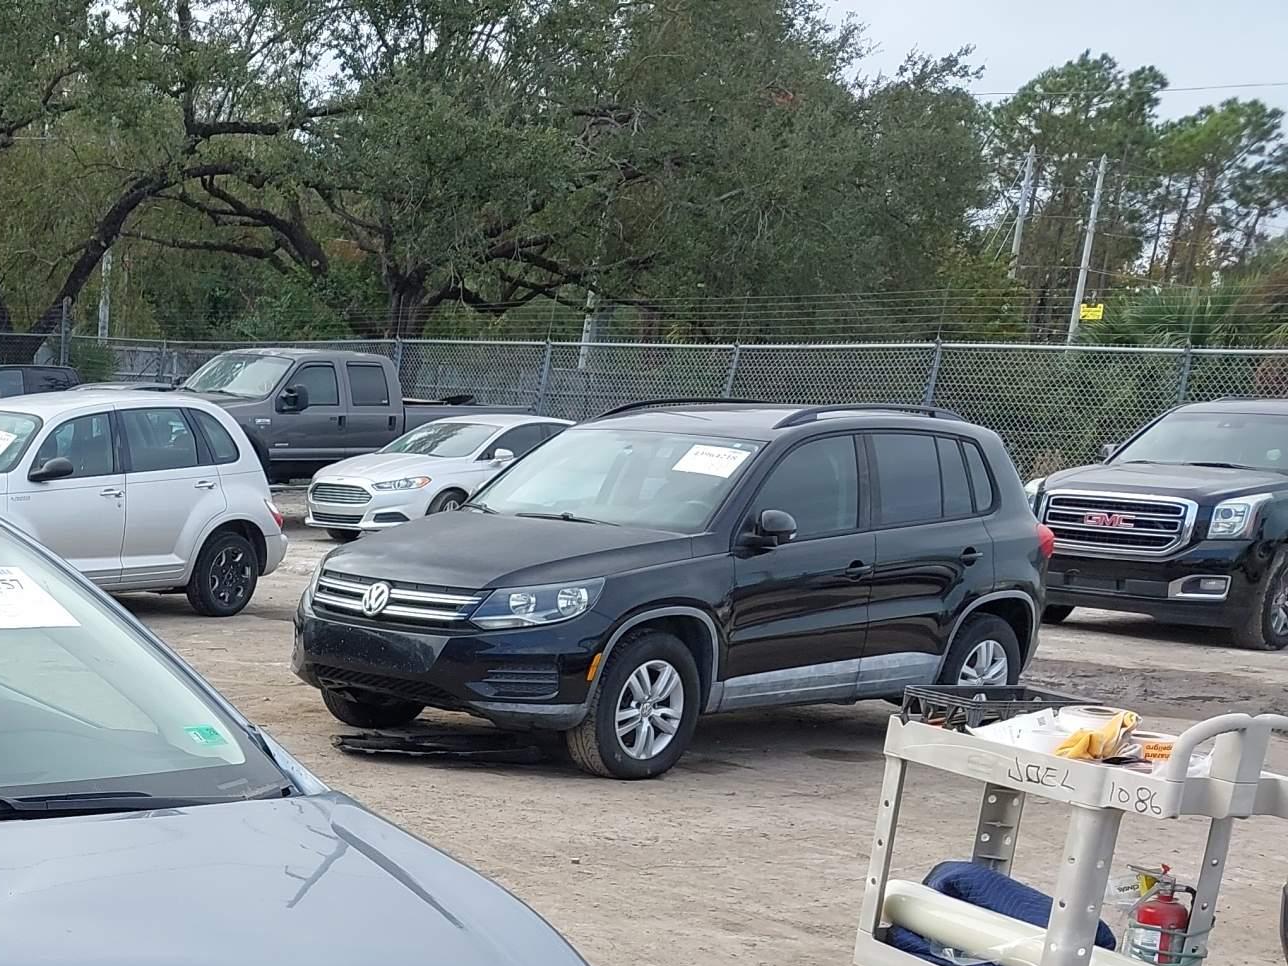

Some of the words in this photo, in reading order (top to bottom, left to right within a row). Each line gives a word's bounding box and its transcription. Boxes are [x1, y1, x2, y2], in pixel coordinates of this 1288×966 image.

[1083, 512, 1136, 528] GMC
[1008, 756, 1075, 791] JOEL
[1110, 781, 1162, 815] 1086
